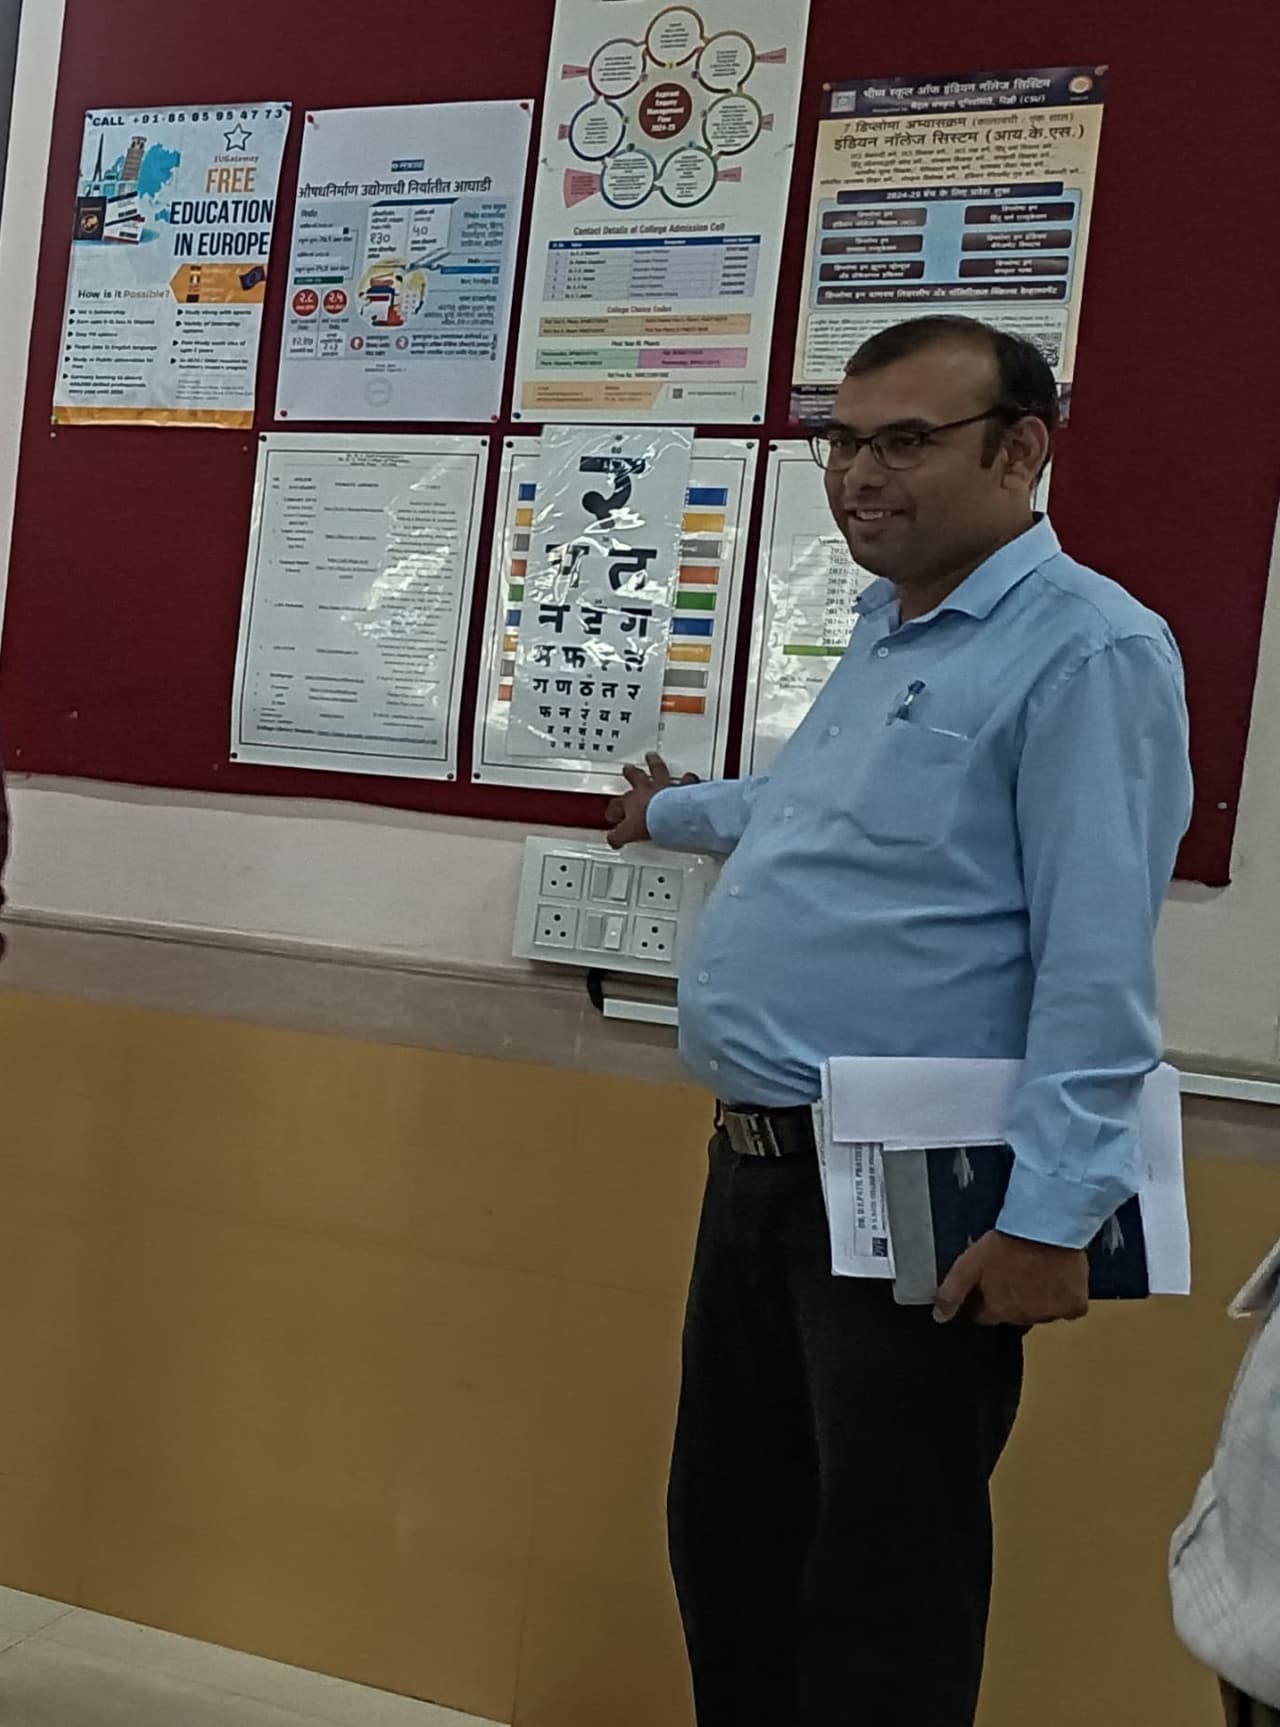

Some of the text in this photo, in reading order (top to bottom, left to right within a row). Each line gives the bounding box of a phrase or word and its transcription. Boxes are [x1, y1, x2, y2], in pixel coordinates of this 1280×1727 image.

[92, 117, 125, 127] CALL
[265, 108, 283, 120] 73
[833, 135, 879, 151] इंडियन
[884, 130, 926, 146] नॉलेज
[932, 129, 980, 145] सिस्टम
[206, 167, 257, 194] FREE
[297, 176, 492, 199] औषधनिर्माण उद्योगाची निर्यातीत आघाडी
[169, 200, 274, 225] EDUCATION
[573, 226, 601, 237] Contact
[603, 224, 628, 235] Details
[639, 224, 667, 235] College
[669, 223, 709, 234] Admission
[174, 231, 270, 257] IN EUROPE
[78, 289, 170, 299] How is it Possible?
[538, 604, 571, 633] न
